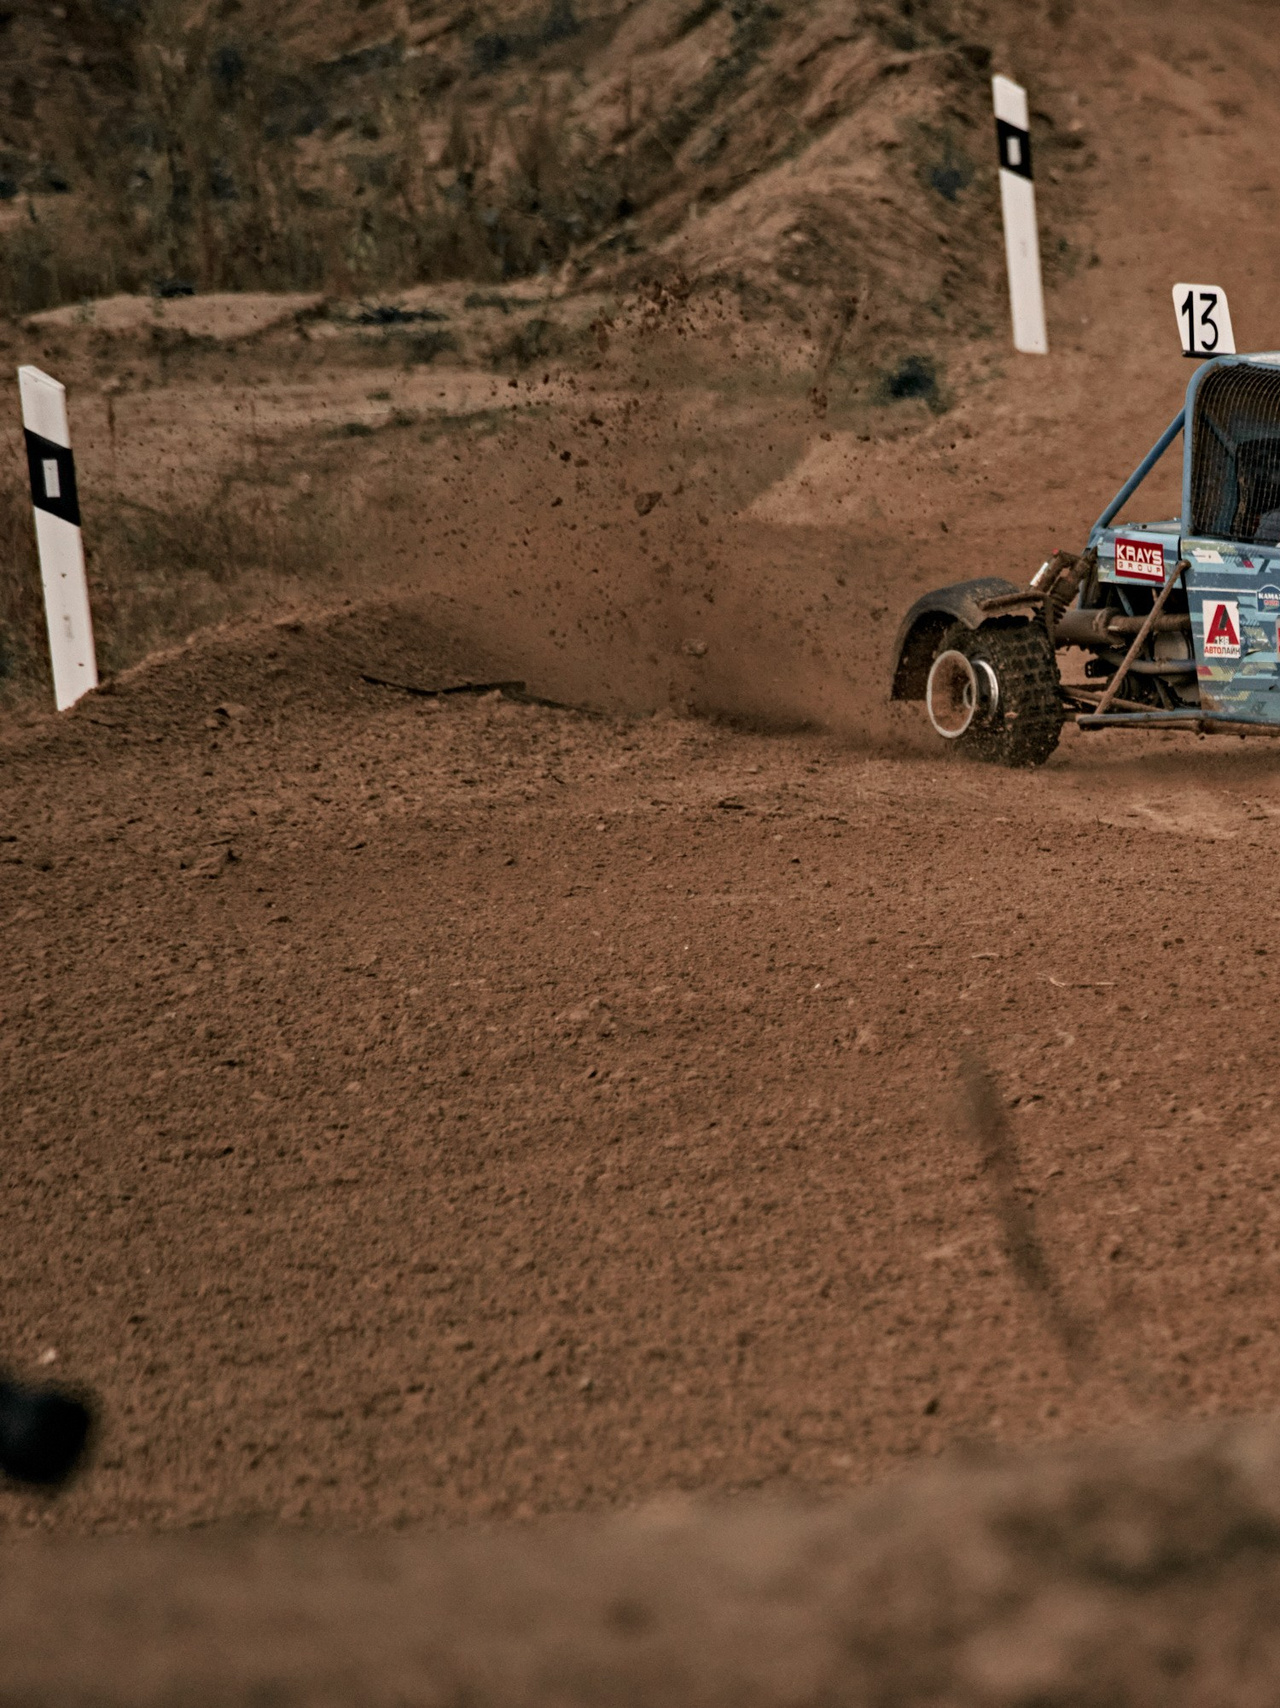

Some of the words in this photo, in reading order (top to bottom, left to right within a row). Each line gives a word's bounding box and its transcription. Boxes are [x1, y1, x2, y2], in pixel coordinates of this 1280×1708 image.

[1181, 290, 1219, 352] 13
[1116, 544, 1163, 568] KRAYS
[1119, 561, 1162, 573] GROUP
